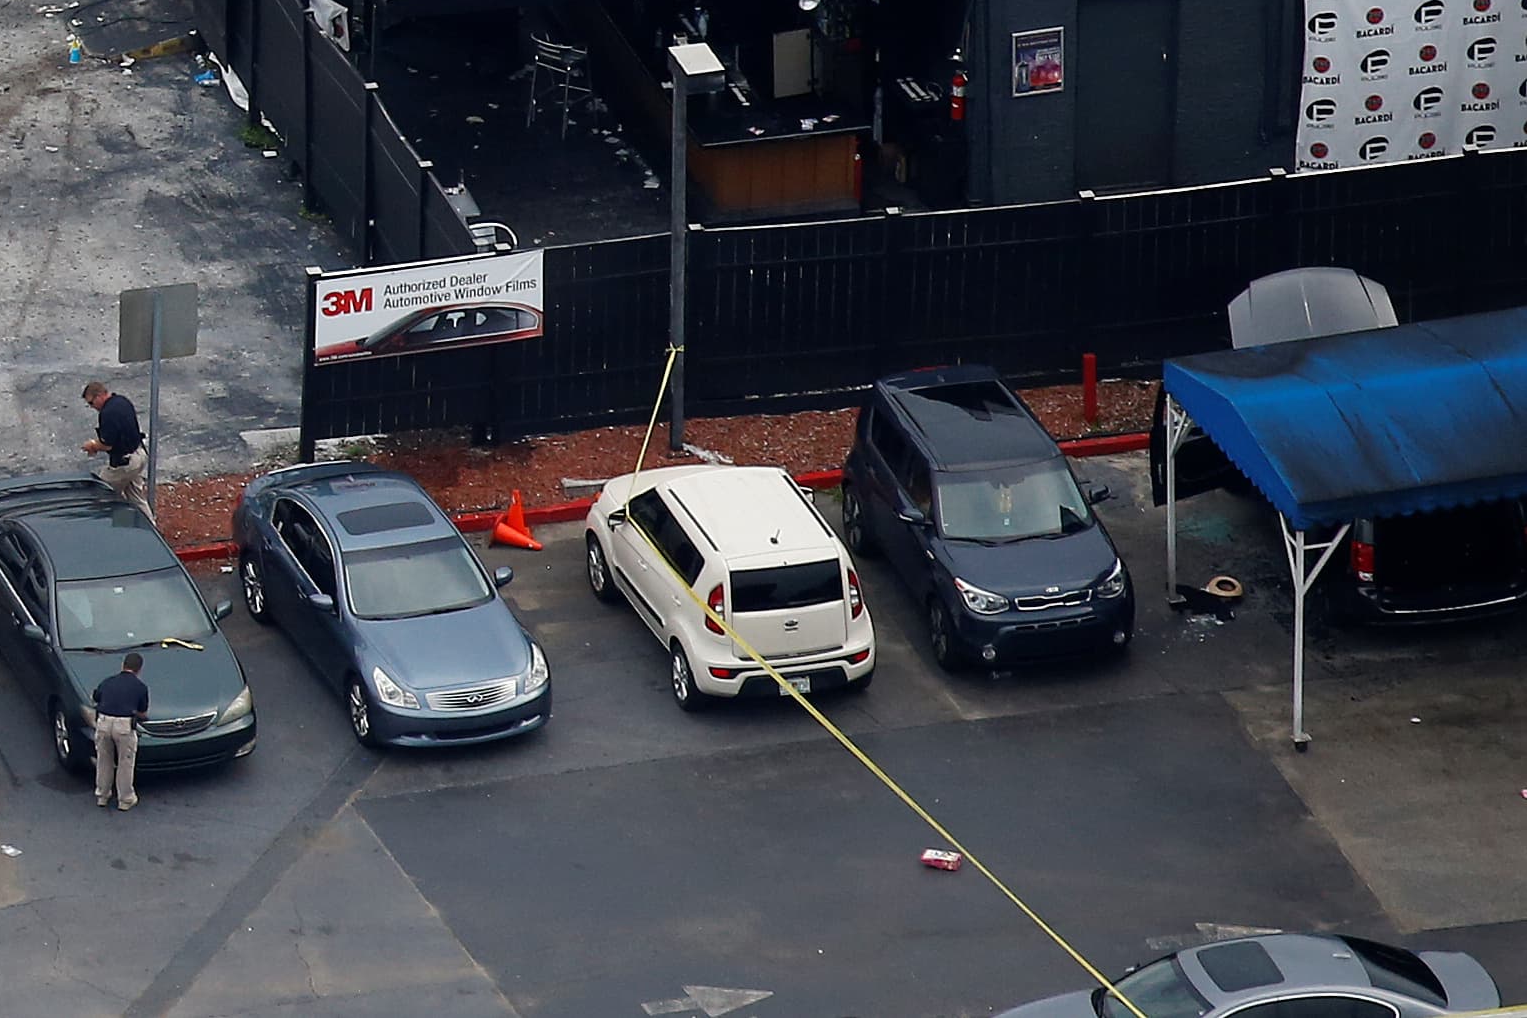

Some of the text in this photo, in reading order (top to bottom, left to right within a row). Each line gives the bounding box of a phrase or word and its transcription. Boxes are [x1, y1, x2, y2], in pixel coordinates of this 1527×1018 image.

[1463, 12, 1501, 25] BACARDÍ
[1356, 25, 1394, 38] BACARDÍ
[1409, 62, 1447, 75] BACARDÍ
[1461, 99, 1500, 112] BACARDÍ
[1354, 112, 1393, 125] BACARDÍ
[384, 273, 488, 296] Authorized Dealer
[383, 279, 537, 309] Automotive Window Films
[322, 288, 373, 316] 3M
